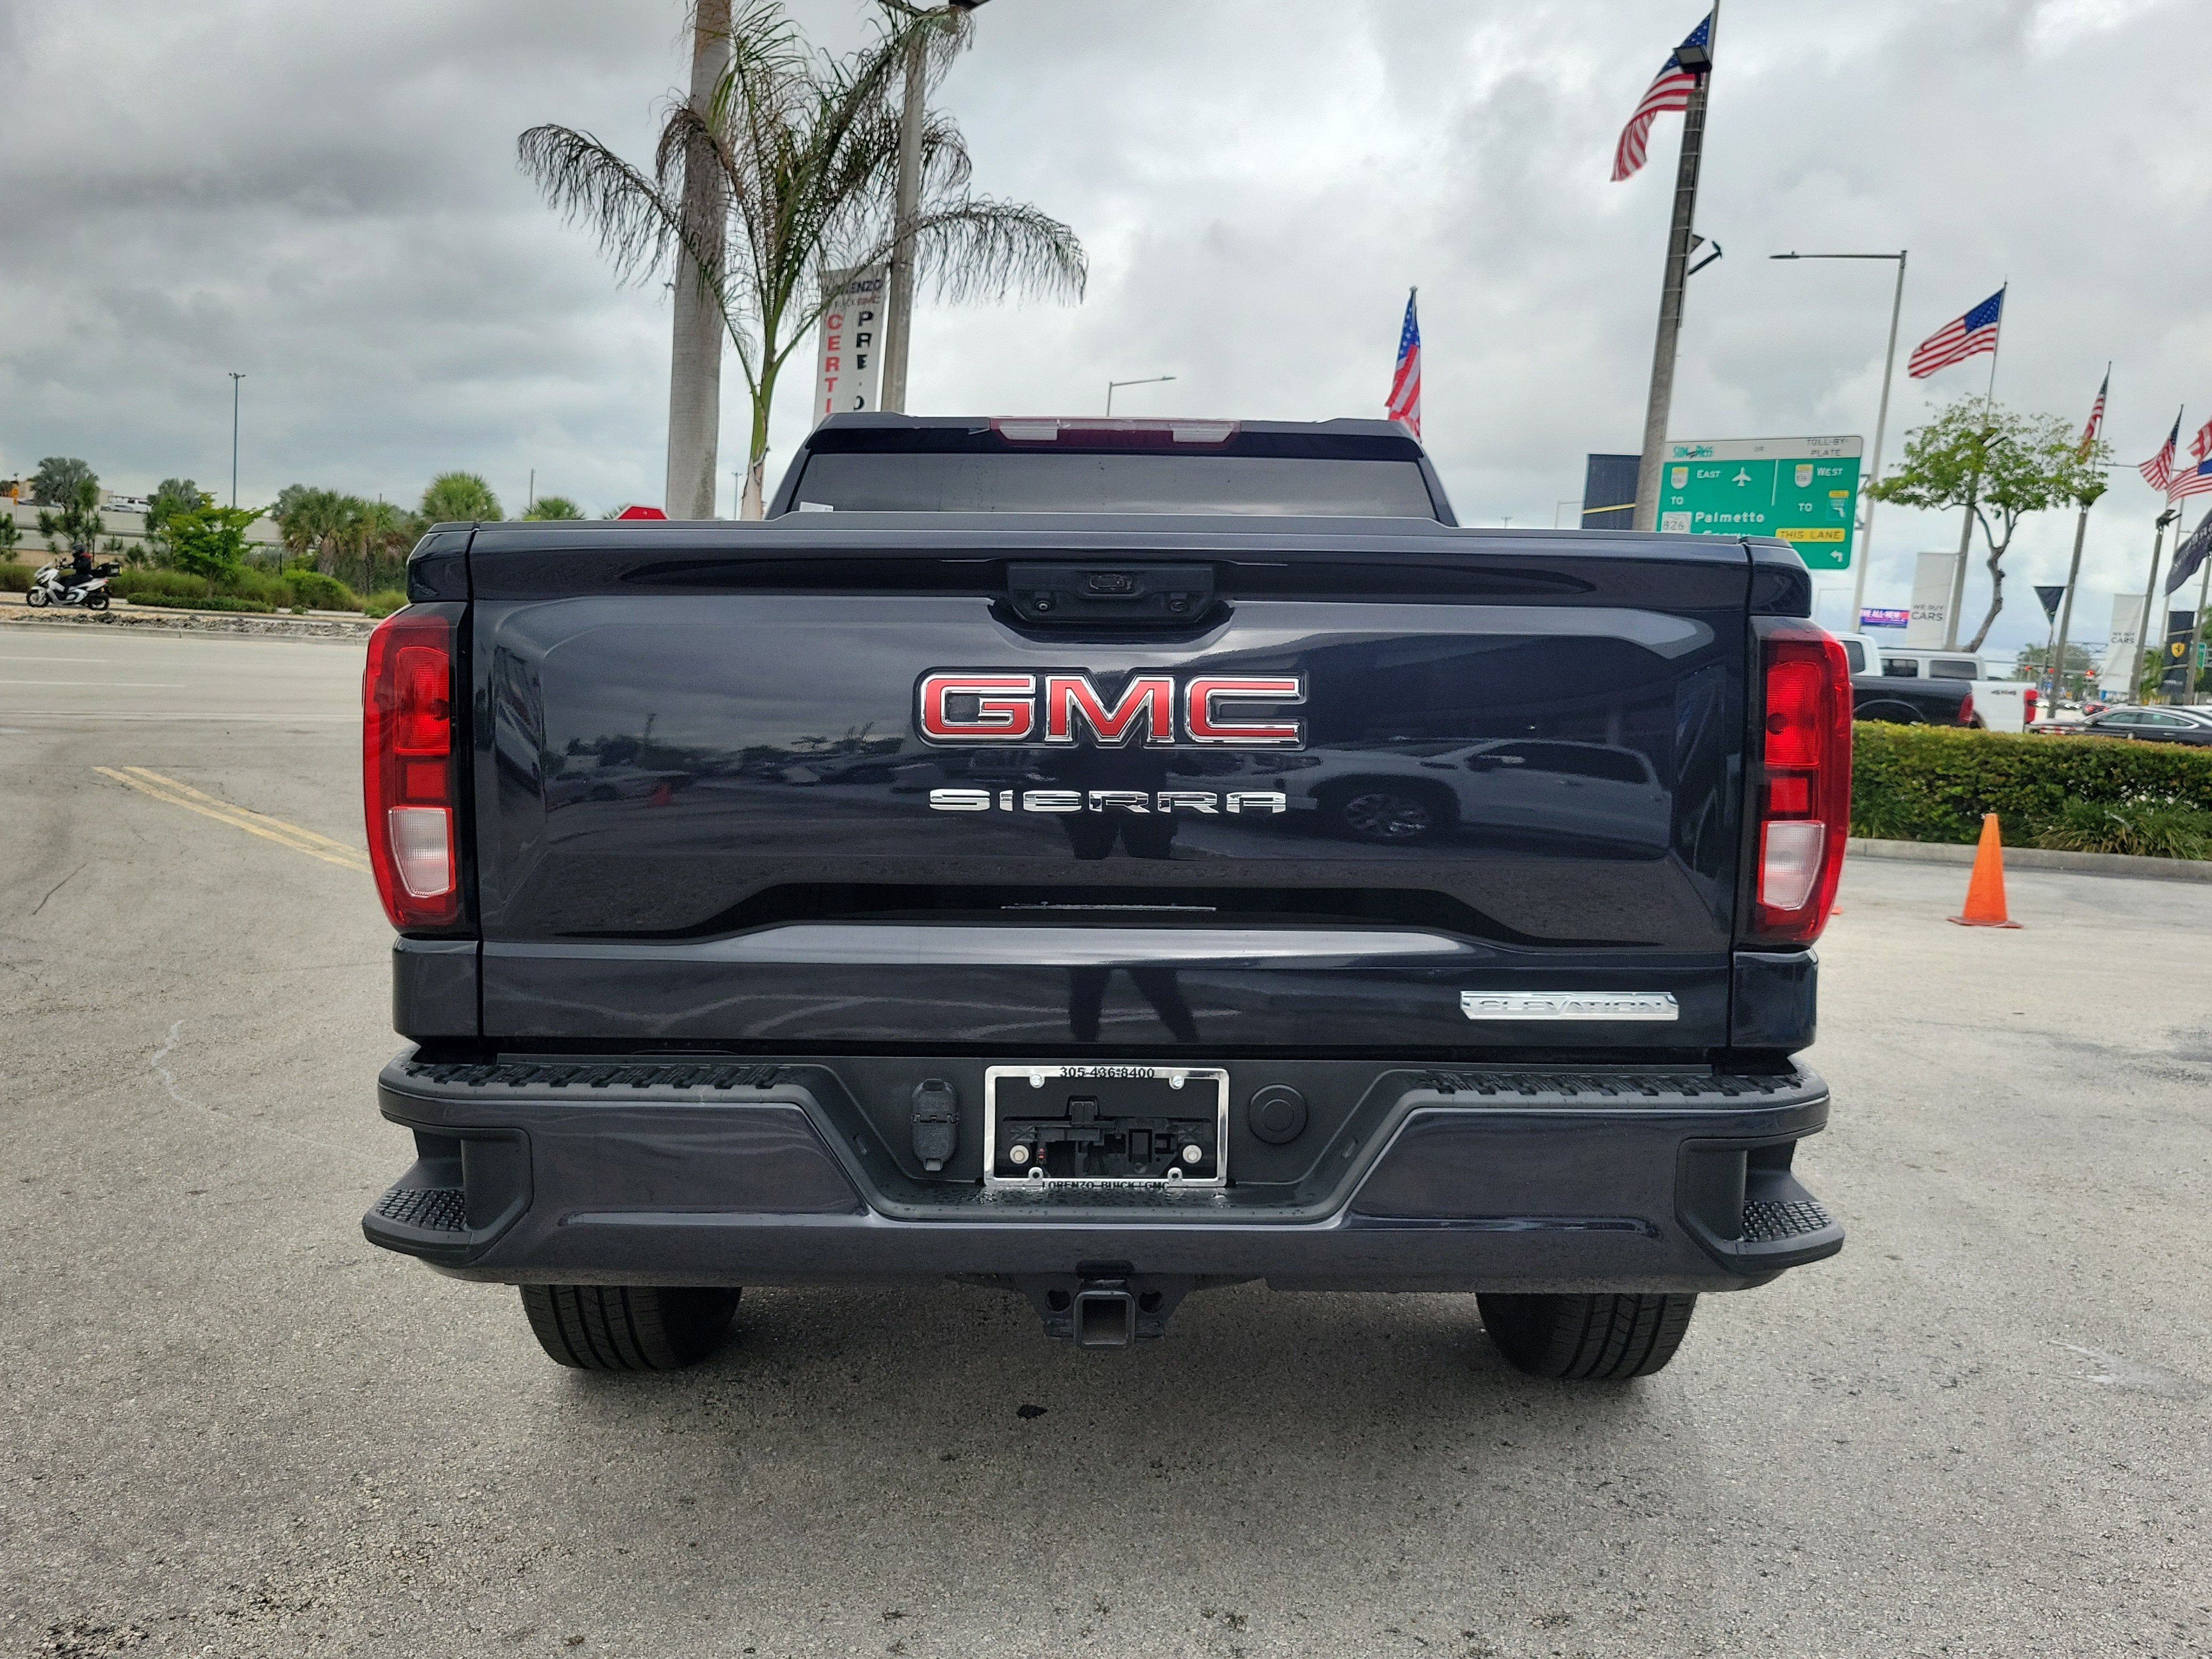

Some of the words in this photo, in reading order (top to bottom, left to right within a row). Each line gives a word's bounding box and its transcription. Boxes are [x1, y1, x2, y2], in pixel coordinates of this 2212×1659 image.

[1697, 469, 1721, 478] EAST
[1817, 467, 1843, 476] WEST
[1671, 496, 1684, 505] TO
[1798, 503, 1813, 512] TO
[1695, 511, 1765, 523] Palmetto
[1811, 531, 1841, 539] LANE
[1911, 611, 1943, 621] CARS
[921, 674, 1301, 743] GMC
[929, 789, 1286, 813] SIERRA
[1480, 997, 1661, 1013] ELEVATION
[1060, 1066, 1155, 1078] 305-436-8400
